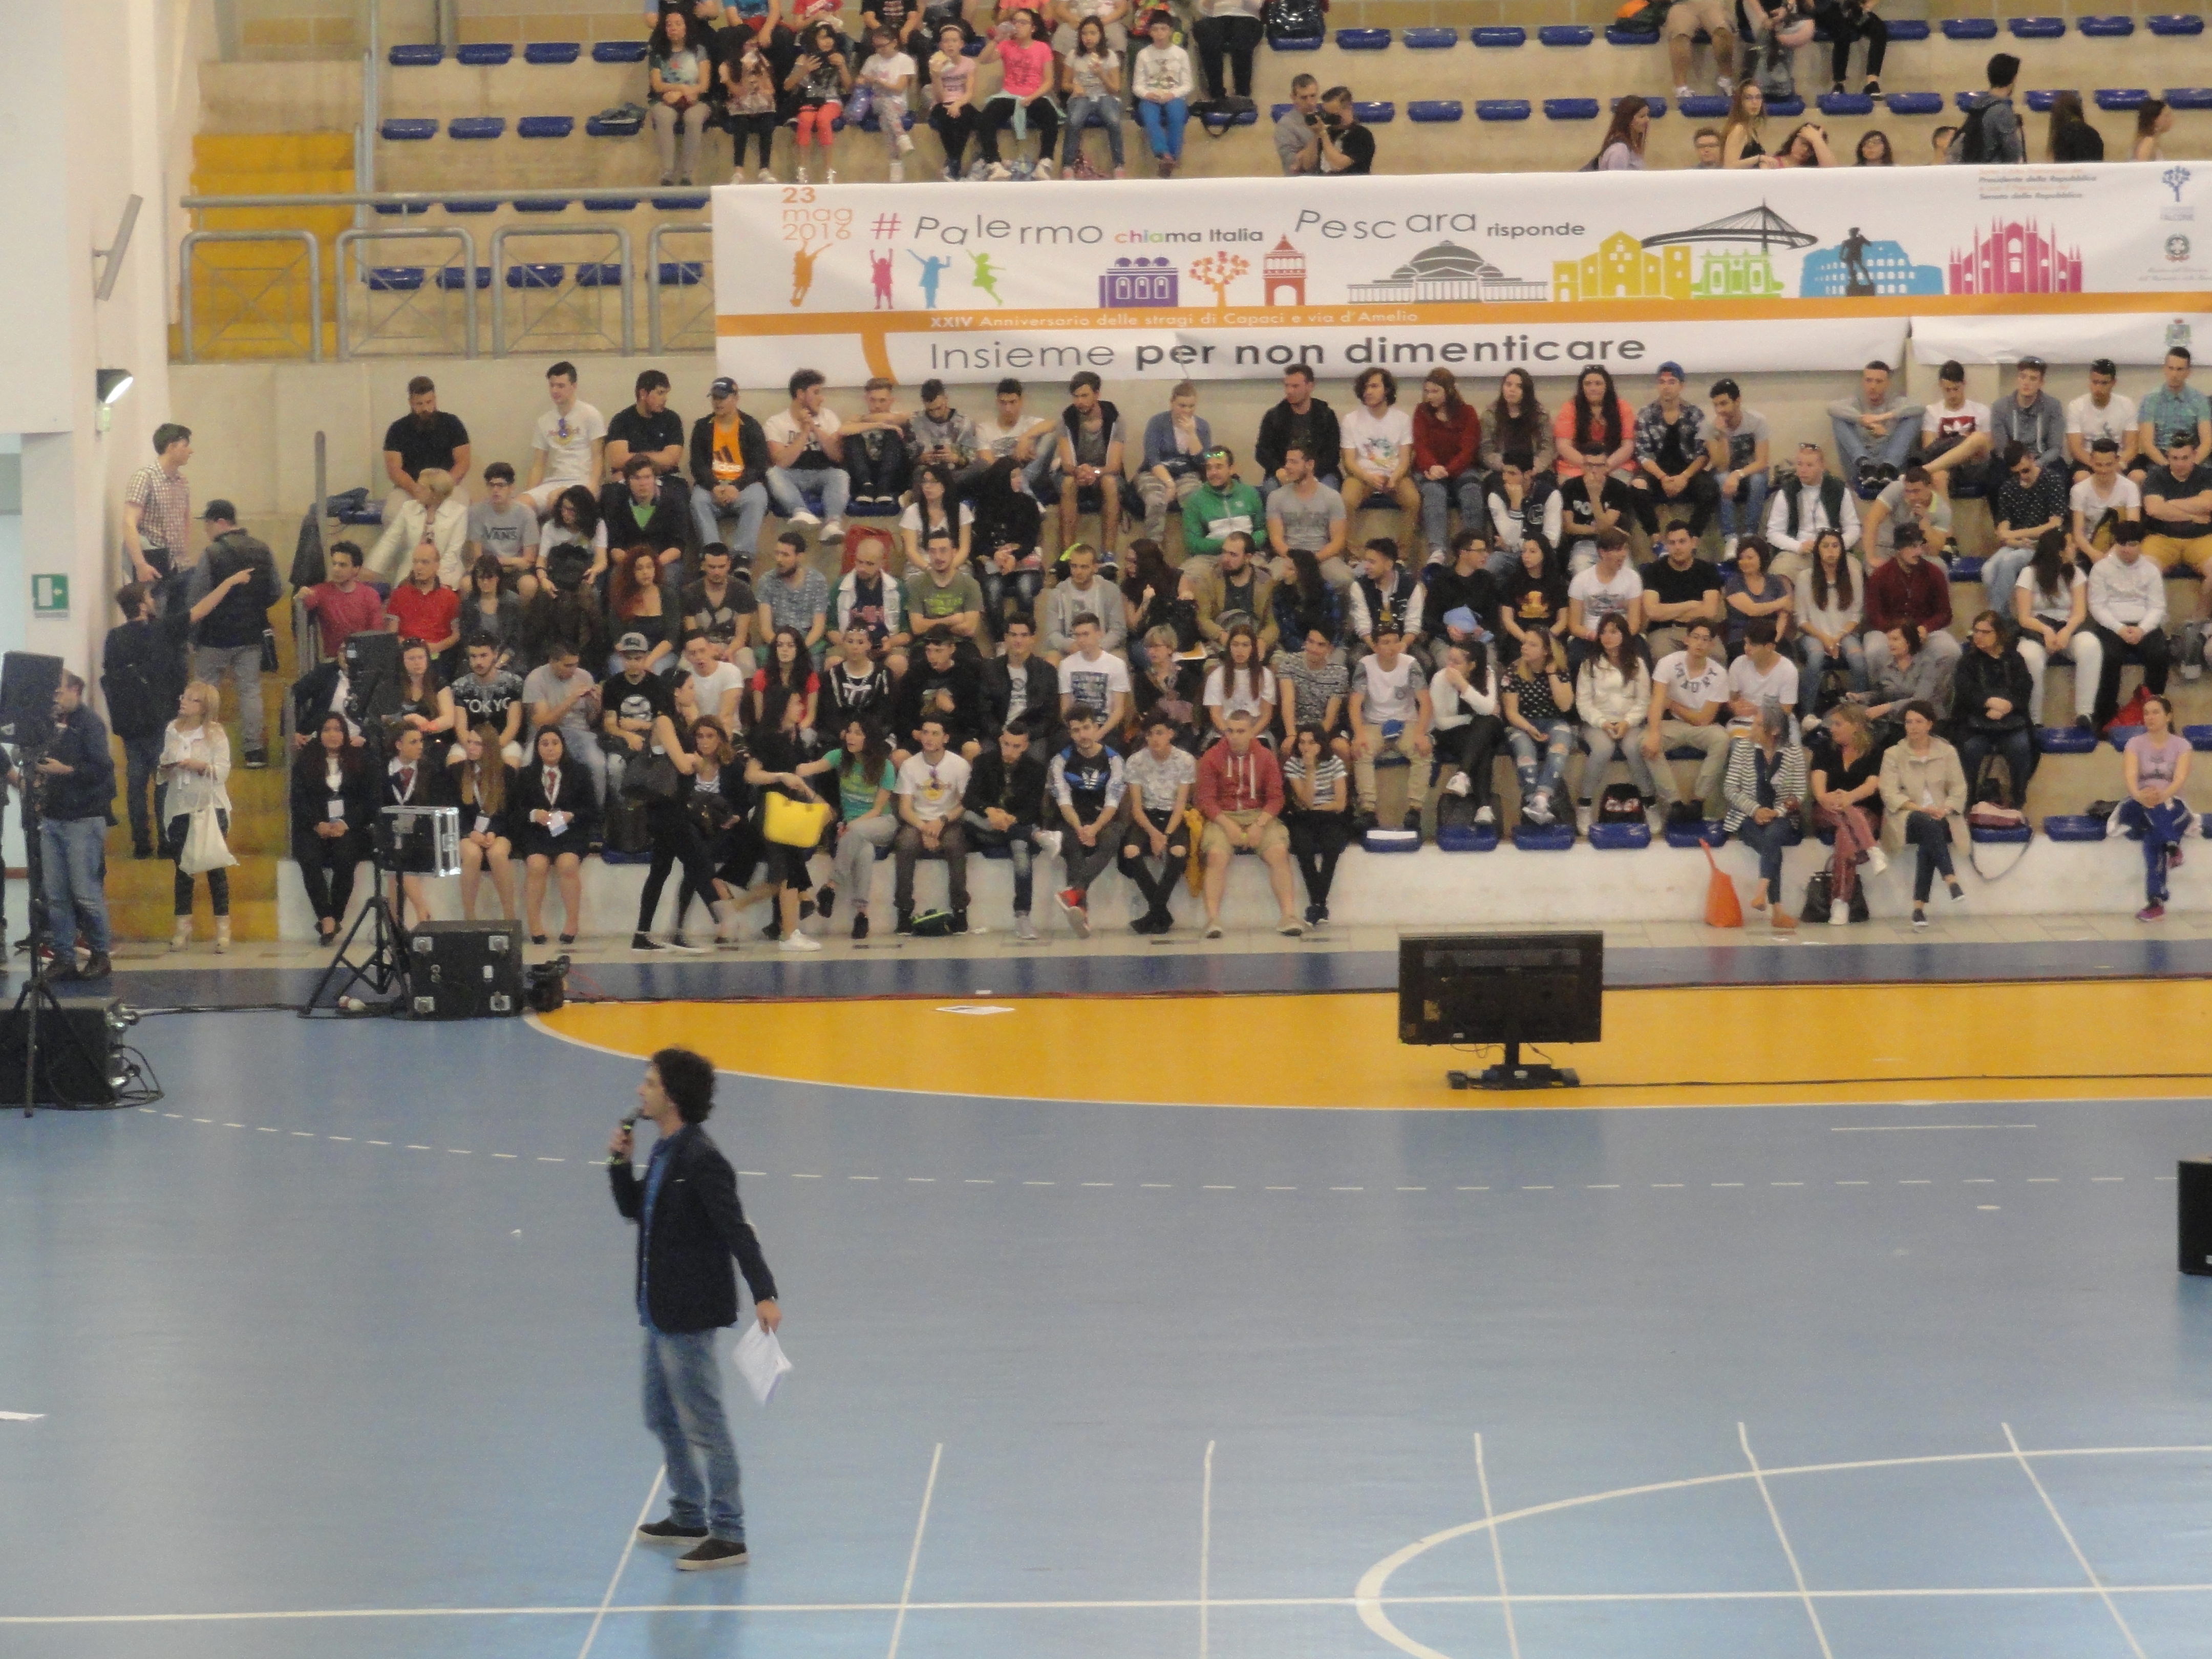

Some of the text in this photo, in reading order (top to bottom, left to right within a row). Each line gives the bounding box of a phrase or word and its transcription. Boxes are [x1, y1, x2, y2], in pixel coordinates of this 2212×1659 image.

[782, 186, 816, 203] 23
[782, 208, 853, 225] mag
[782, 223, 852, 240] 2016
[1114, 229, 1202, 244] chiama
[1209, 227, 1263, 242] Italia
[1294, 209, 1477, 240] Pescara
[1486, 222, 1585, 240] risponde
[930, 316, 973, 328] XXIV
[979, 314, 1090, 327] Anniversario
[1097, 313, 1138, 326] delle
[1145, 313, 1194, 327] stragi
[1200, 312, 1218, 325] di
[1223, 311, 1285, 326] Capaci
[1291, 314, 1302, 323] e
[1308, 312, 1334, 323] via
[931, 334, 1647, 372] Insieme per non dimenticare
[483, 525, 517, 541] VANS
